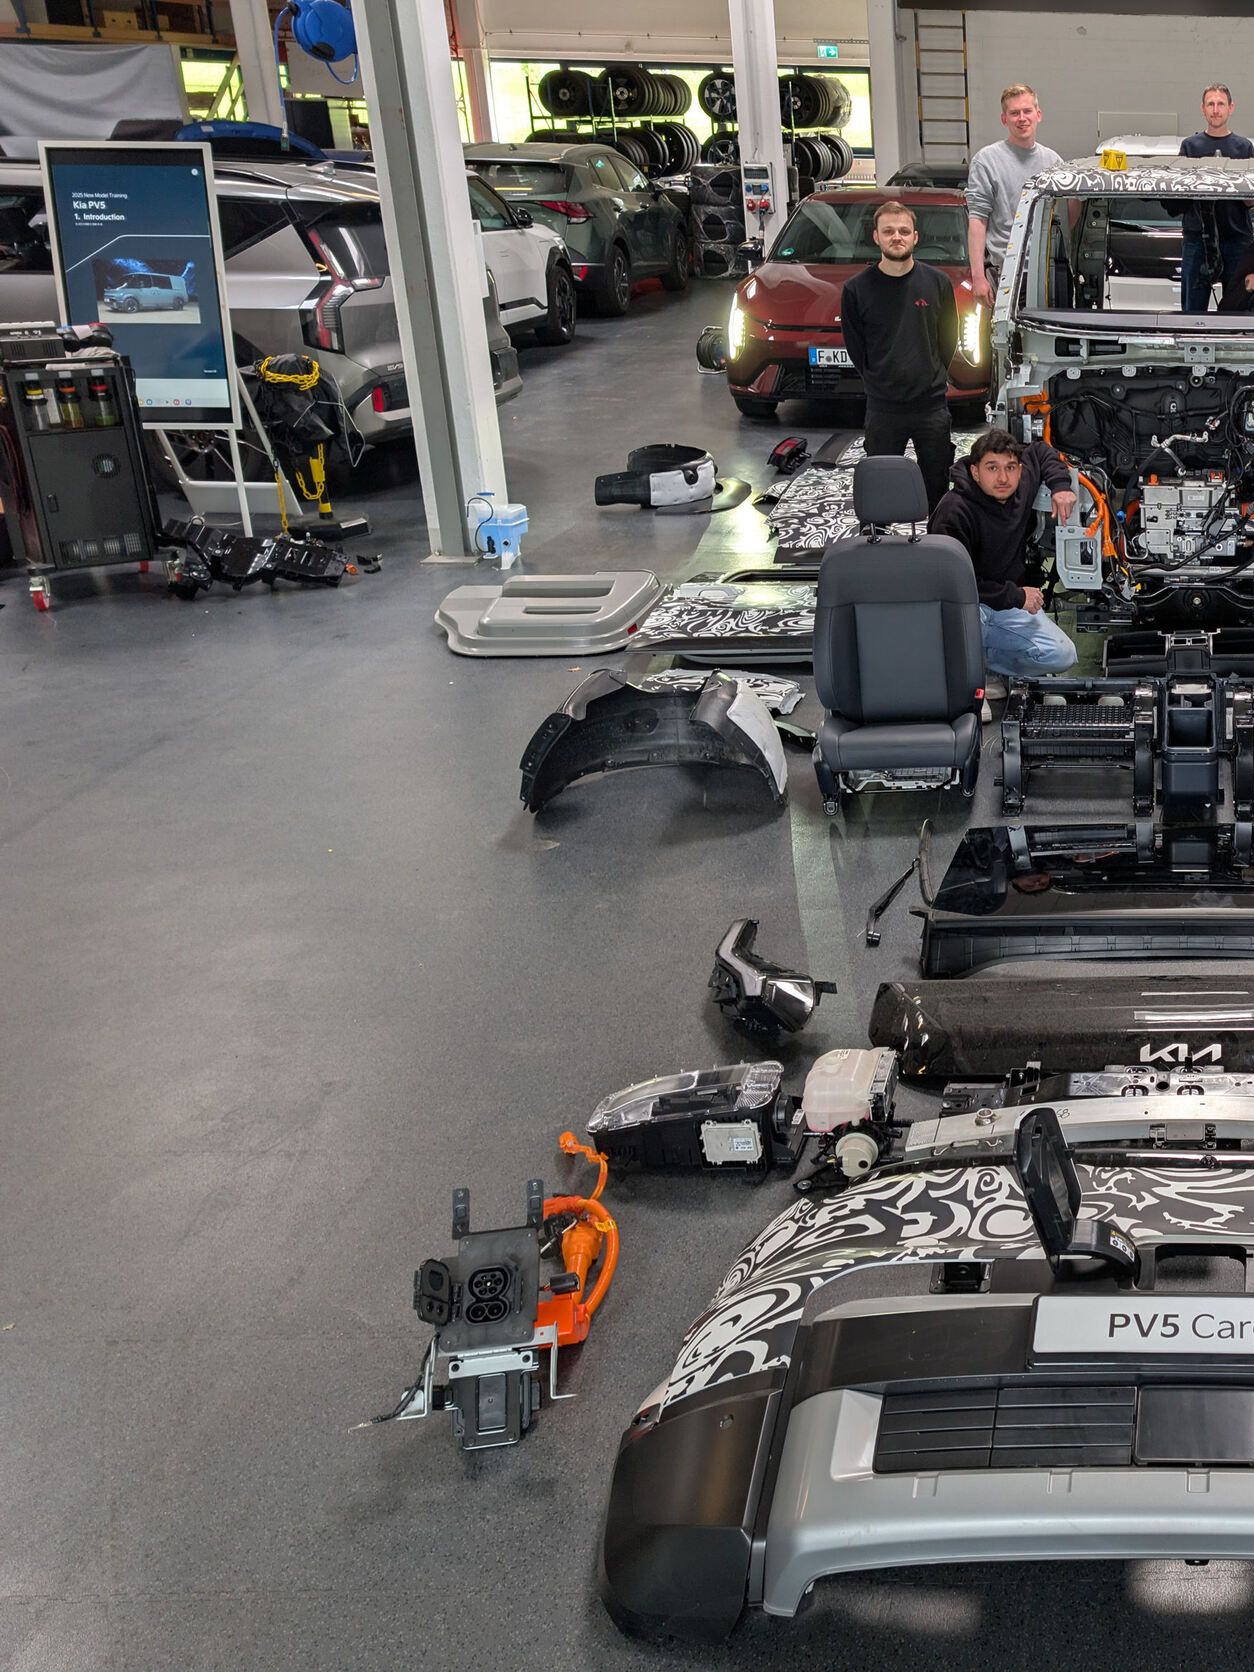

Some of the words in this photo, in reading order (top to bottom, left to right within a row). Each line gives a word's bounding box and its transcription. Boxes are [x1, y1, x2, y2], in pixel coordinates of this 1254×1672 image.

[109, 192, 128, 200] Training
[73, 200, 87, 209] Kia
[88, 200, 106, 209] PV5
[818, 350, 825, 363] F
[1140, 1043, 1222, 1062] KIA
[1108, 1313, 1180, 1338] PV5
